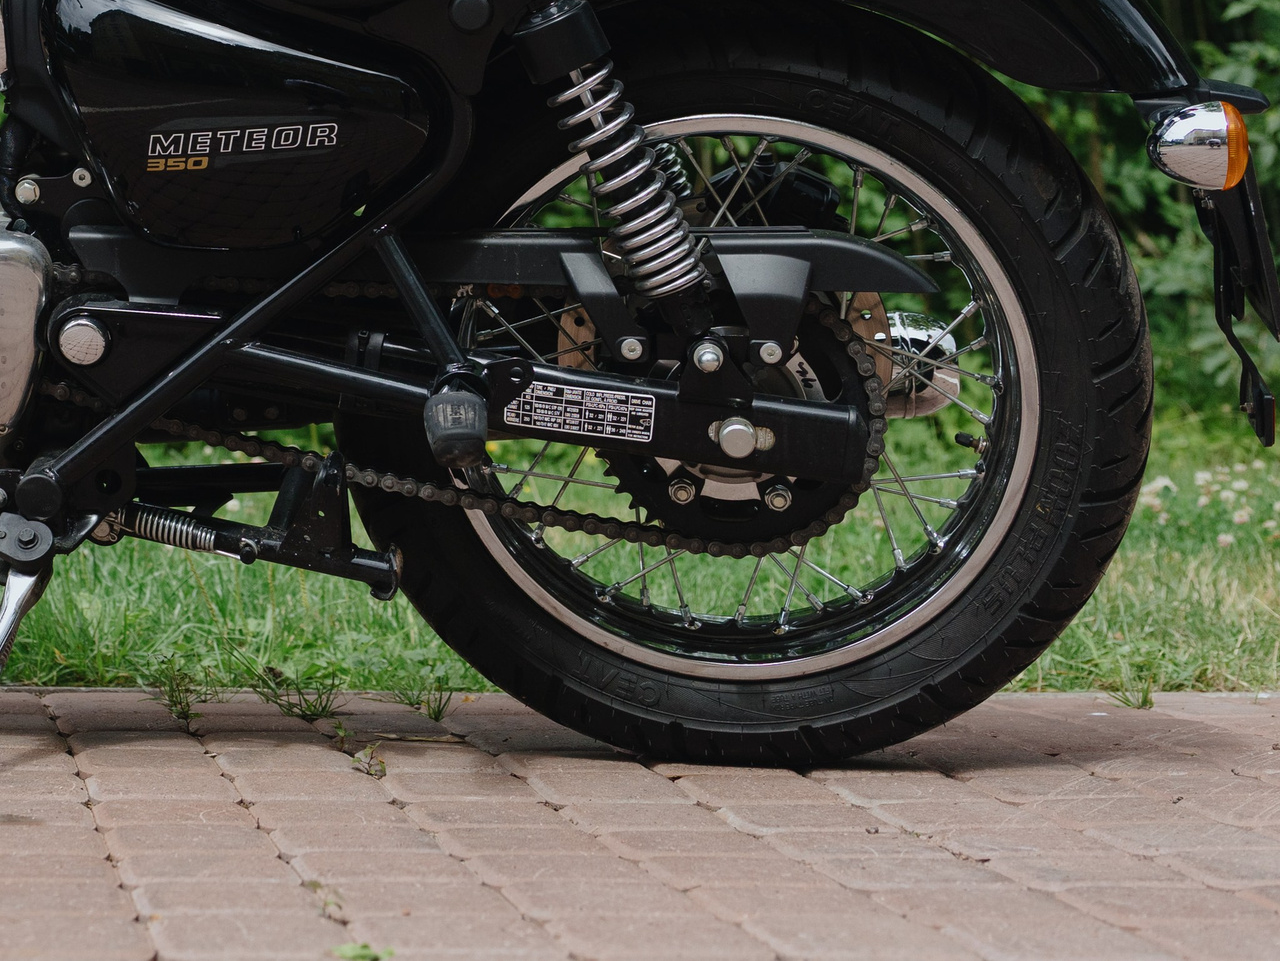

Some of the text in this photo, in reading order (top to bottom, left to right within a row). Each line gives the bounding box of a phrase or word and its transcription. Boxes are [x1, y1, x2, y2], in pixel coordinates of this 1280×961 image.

[148, 123, 339, 156] METEOR
[146, 156, 210, 172] 350
[570, 655, 661, 707] CEAT
